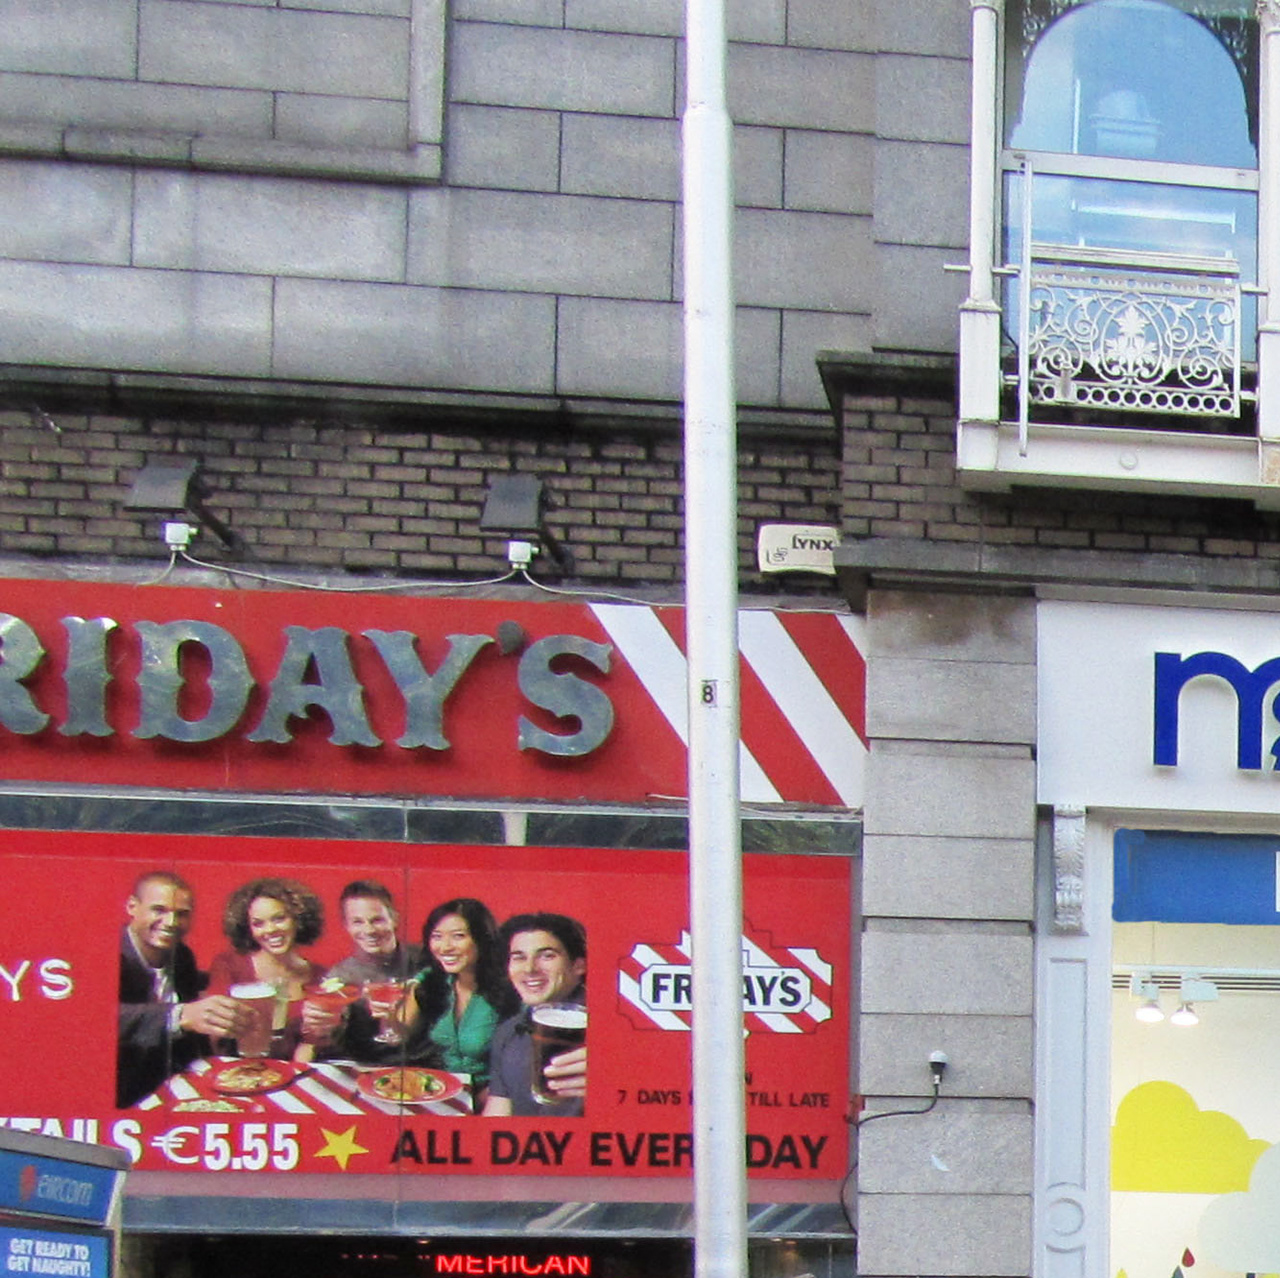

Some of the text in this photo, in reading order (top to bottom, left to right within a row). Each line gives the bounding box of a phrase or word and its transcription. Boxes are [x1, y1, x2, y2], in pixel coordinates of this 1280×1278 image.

[792, 533, 834, 551] LYNX
[702, 684, 714, 704] 8
[651, 971, 803, 1007] FRAY'S
[618, 1090, 628, 1104] 7
[637, 1089, 682, 1105] DAYS
[750, 1091, 782, 1107] TILL
[789, 1092, 830, 1108] LATE
[151, 1123, 300, 1171] €5.55
[391, 1129, 472, 1165] ALL
[491, 1131, 573, 1166] DAY
[590, 1132, 694, 1168] EVER
[10, 1238, 33, 1255] GET
[74, 1244, 90, 1260] TO
[7, 1255, 30, 1272] GET
[436, 1254, 591, 1276] MERICAN
